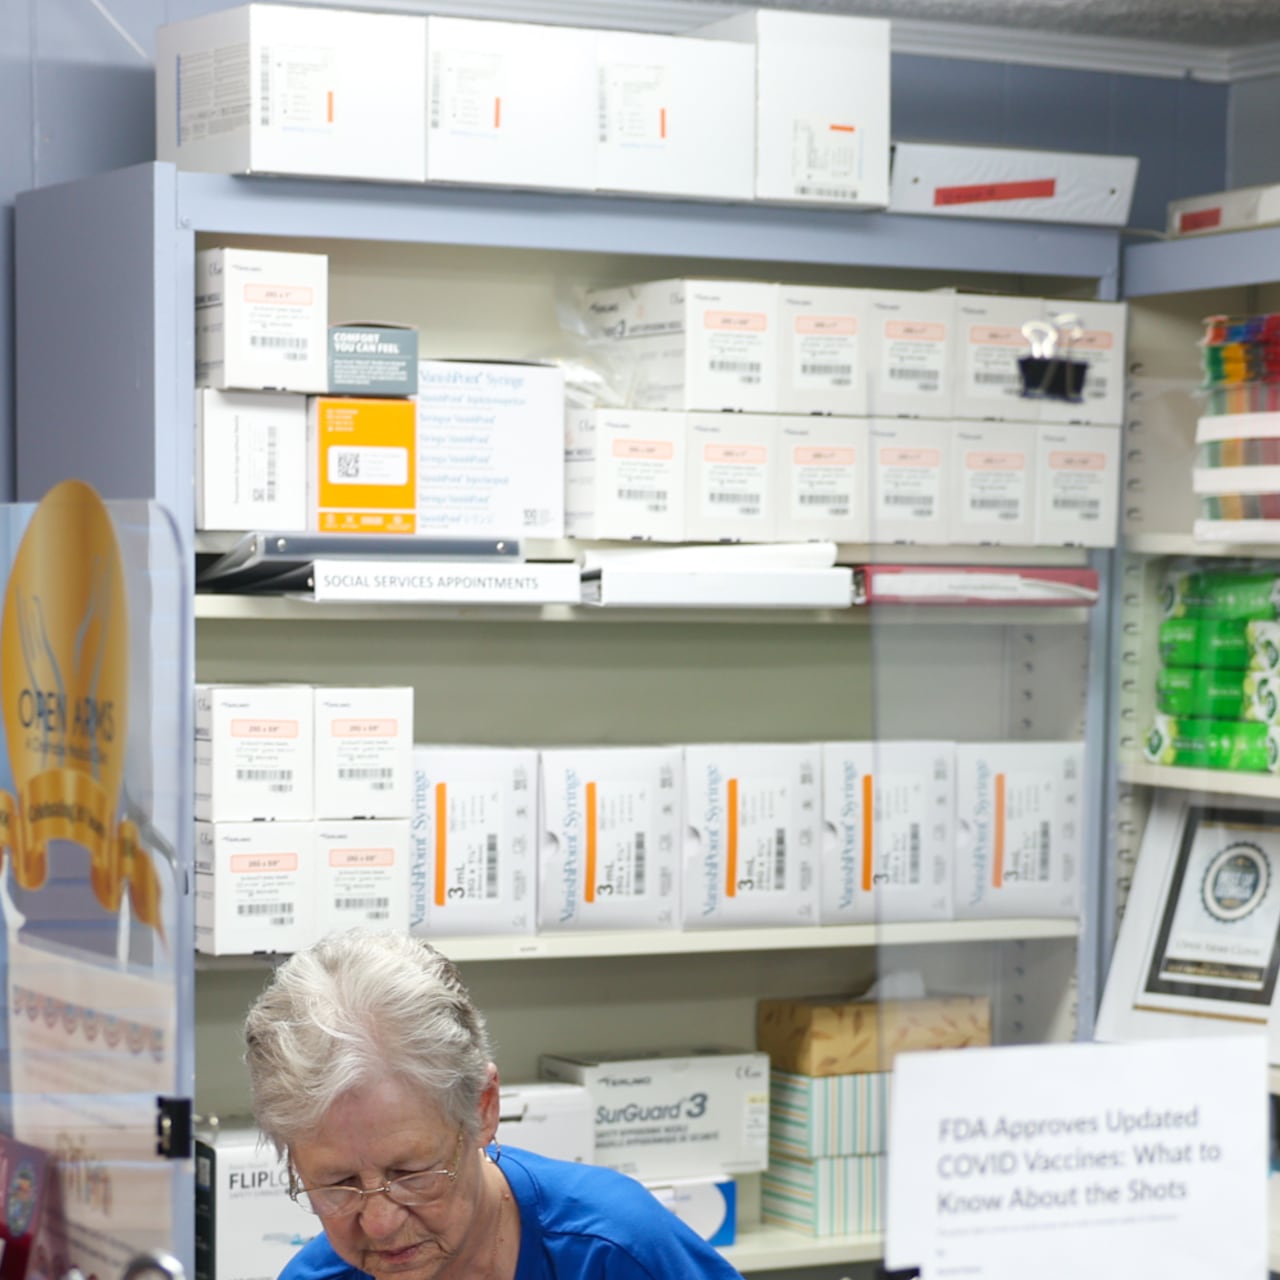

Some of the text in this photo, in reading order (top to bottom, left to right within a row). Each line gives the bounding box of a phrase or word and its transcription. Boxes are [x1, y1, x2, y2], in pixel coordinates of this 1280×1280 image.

[324, 575, 538, 590] SOCIAL SERVICES APPOINTMENTS
[19, 689, 113, 743] OPEN ARMS
[414, 770, 430, 829] Syringe
[564, 768, 580, 829] Syringe
[706, 764, 723, 821] Syringe
[448, 886, 465, 899] 3
[597, 884, 614, 895] 3
[738, 878, 754, 890] 3
[595, 1093, 709, 1124] SurGuard 3
[938, 1106, 1200, 1143] FDA Approves Updated
[937, 1142, 1223, 1179] COVID Vaccines: What to
[937, 1178, 1188, 1215] Know About the Shots
